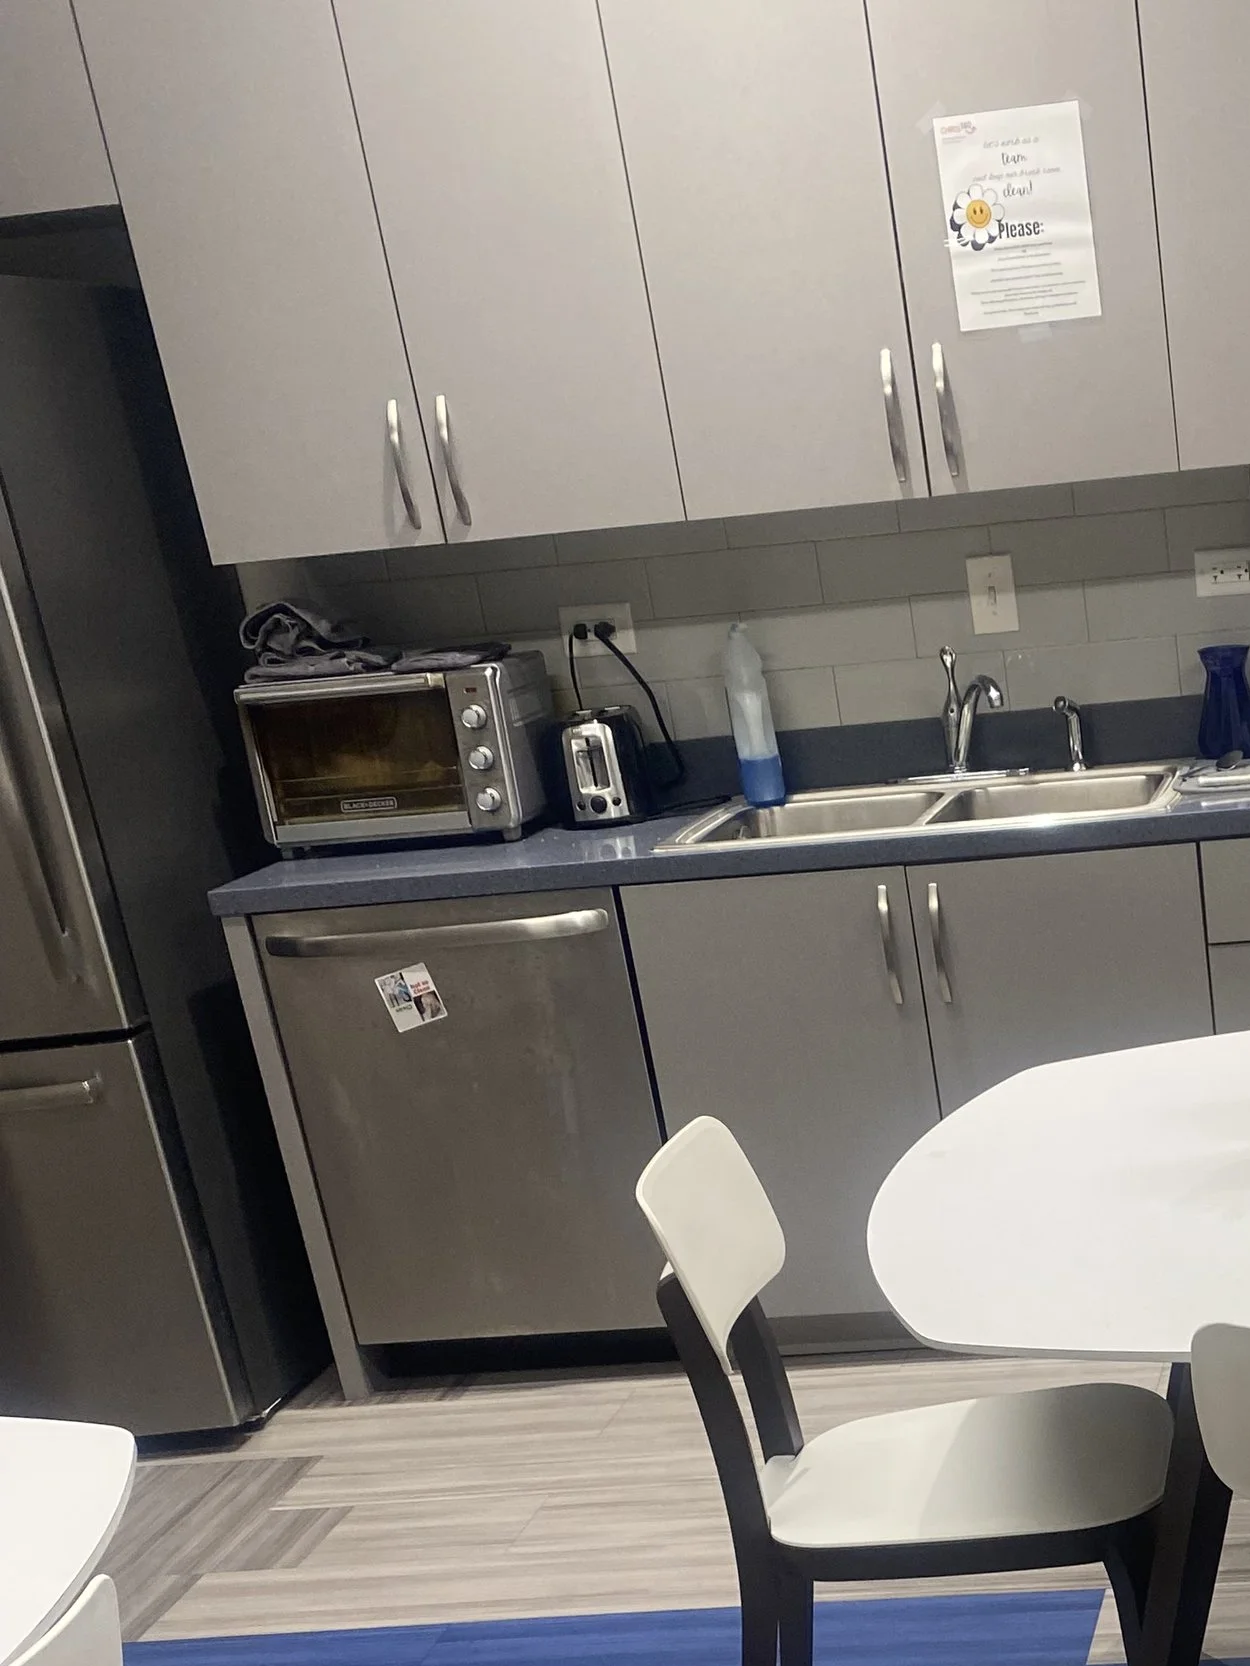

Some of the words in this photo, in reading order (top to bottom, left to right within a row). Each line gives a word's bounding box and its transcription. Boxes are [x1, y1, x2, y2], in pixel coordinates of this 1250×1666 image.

[1001, 152, 1027, 166] team
[1003, 180, 1033, 198] clean!
[998, 221, 1045, 239] Please:
